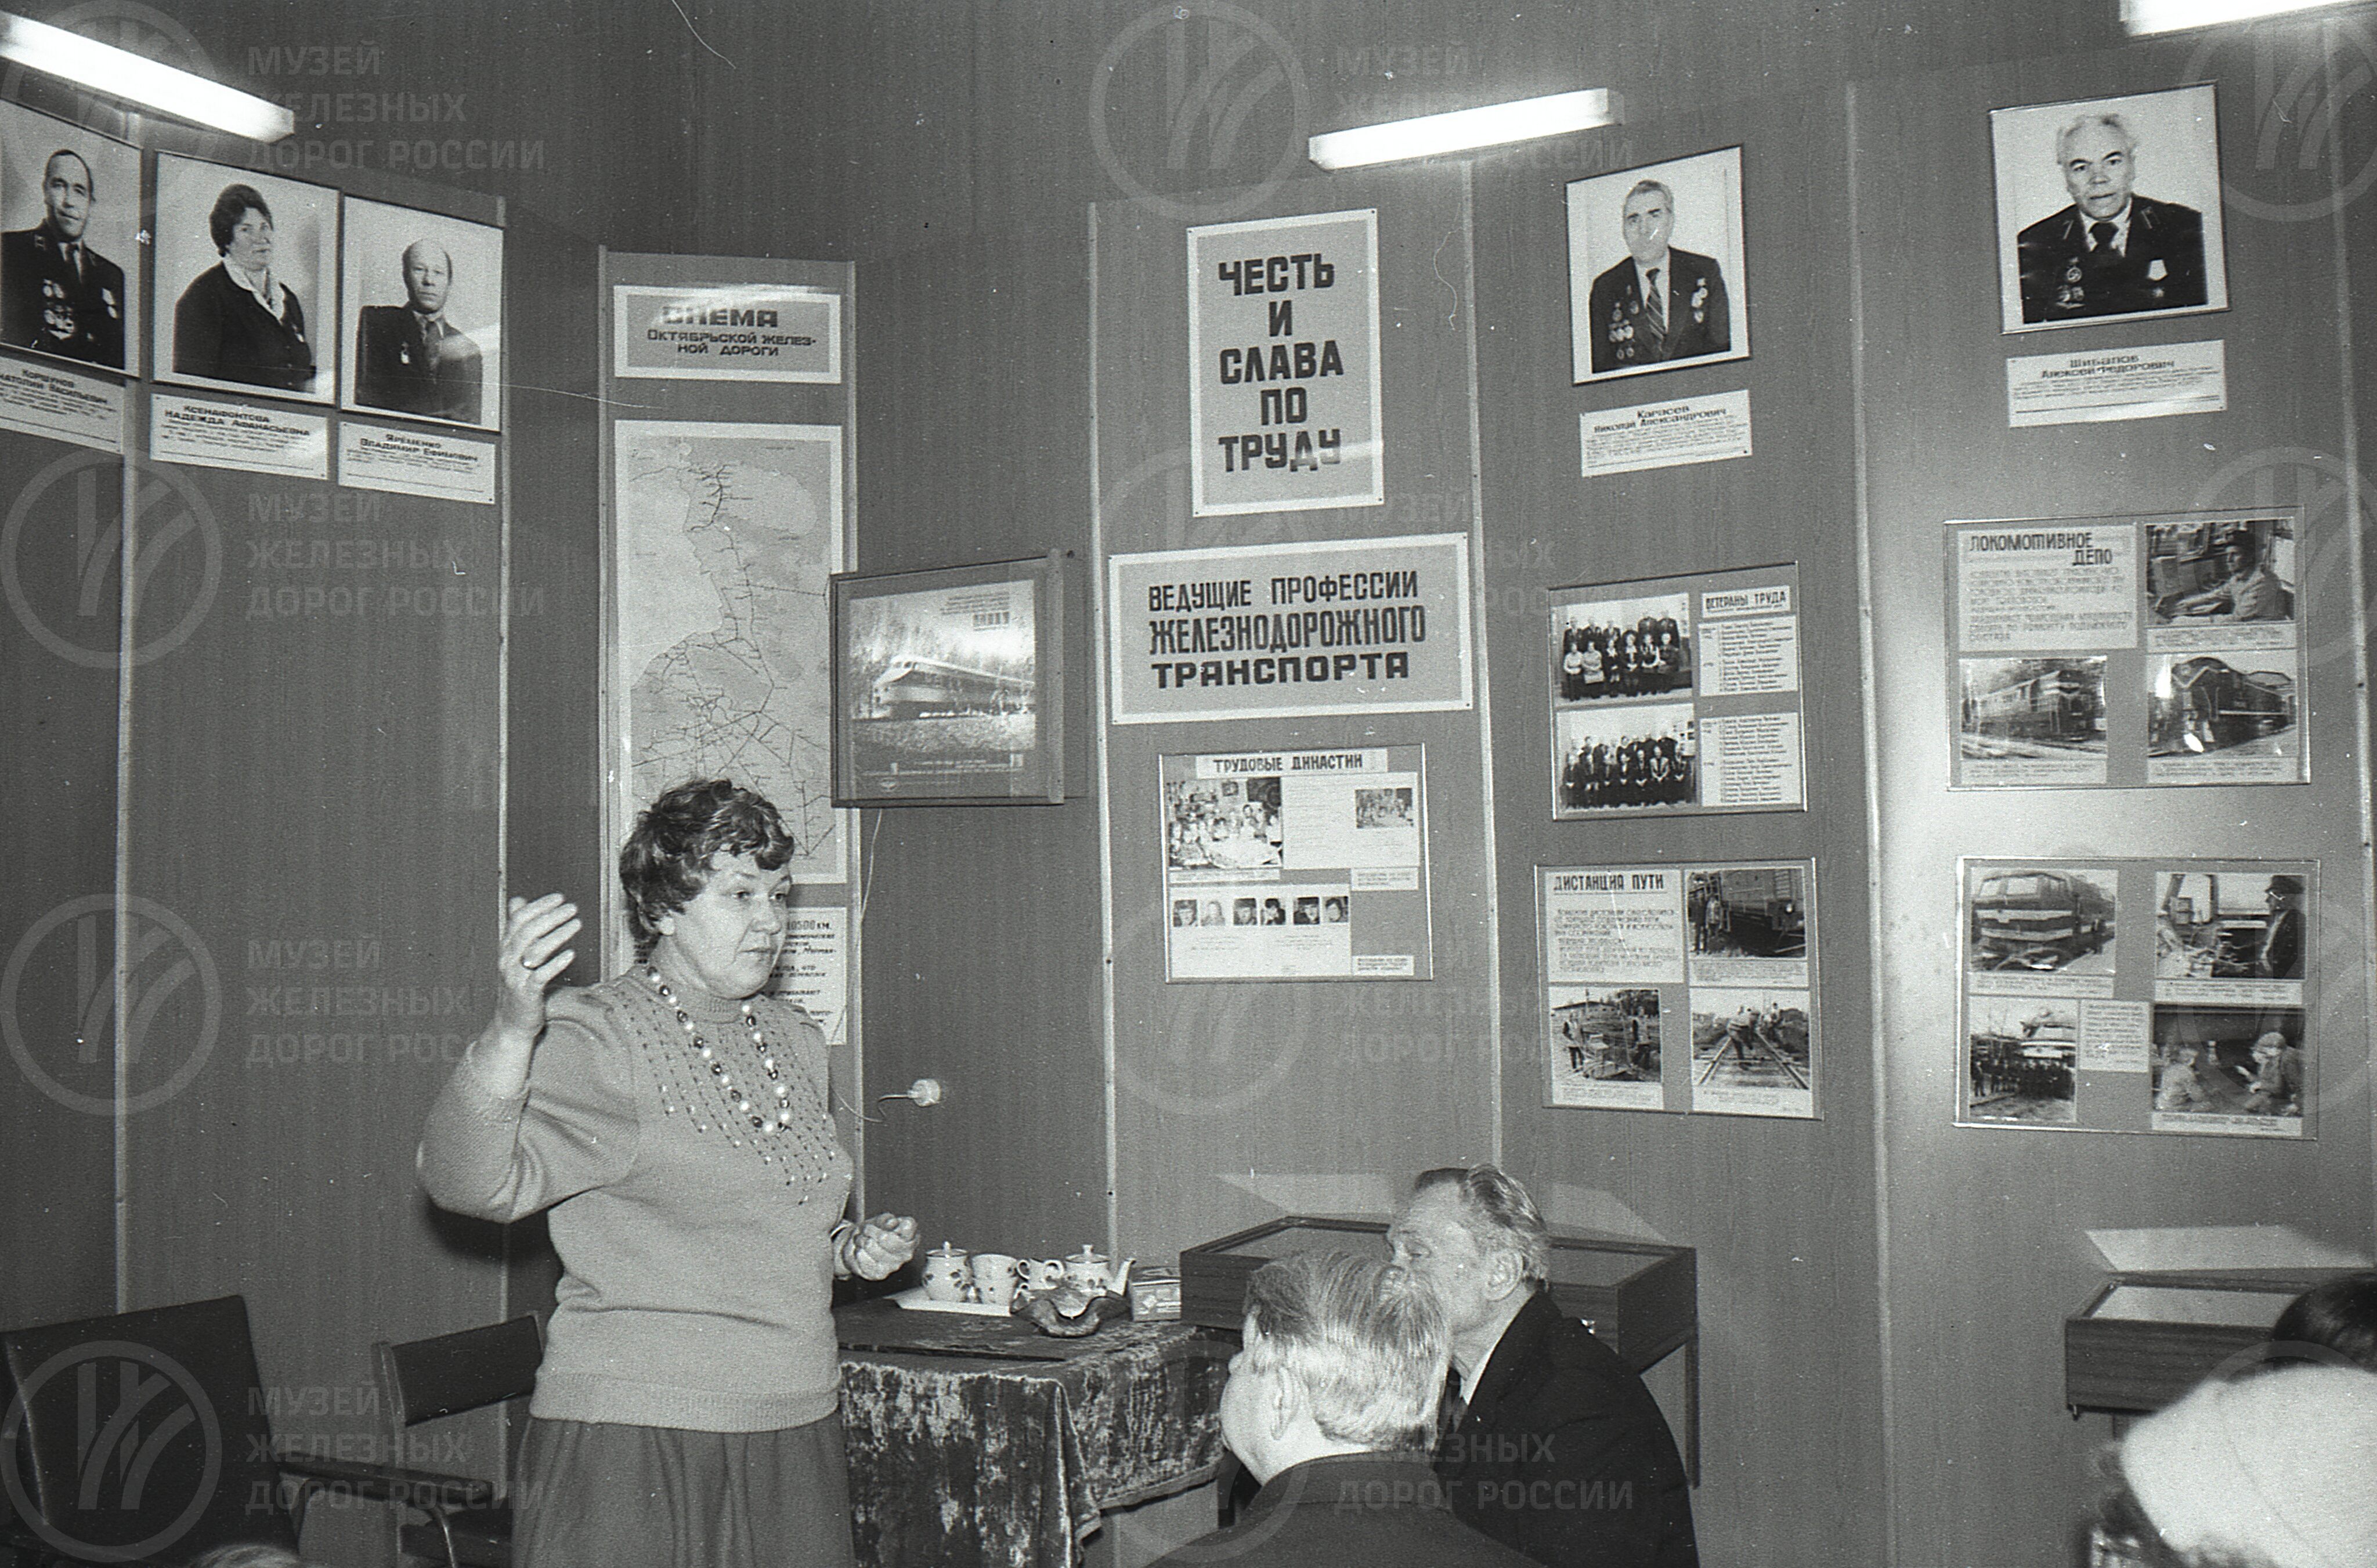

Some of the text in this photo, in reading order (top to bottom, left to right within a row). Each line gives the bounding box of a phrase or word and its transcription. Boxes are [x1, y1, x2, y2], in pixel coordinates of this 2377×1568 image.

[1219, 253, 1335, 295] ЧЕСТЬ
[1268, 300, 1292, 337] И
[678, 343, 778, 356] НОЙ ДОРОГИ
[1220, 340, 1344, 384] СЛАВА
[1260, 387, 1308, 425] ПО
[1218, 428, 1341, 472] ТРУДУ
[1971, 532, 2093, 551] ЛОКОМОТИВНОЕ
[2072, 548, 2113, 566] ДЕПО
[1148, 571, 1418, 612] ВЕДУЩИЕ ПРОФЕССИИ
[1754, 591, 1786, 604] ТРУДА
[1149, 605, 1425, 655] ЖЕЛЕЗНОДОРОЖНОГО
[1151, 652, 1409, 689] ТРАНСПОРТА
[1213, 757, 1283, 773] ТРУДОВЫЕ
[1554, 874, 1664, 891] ДИСТАНЦИЯ ПУТИ
